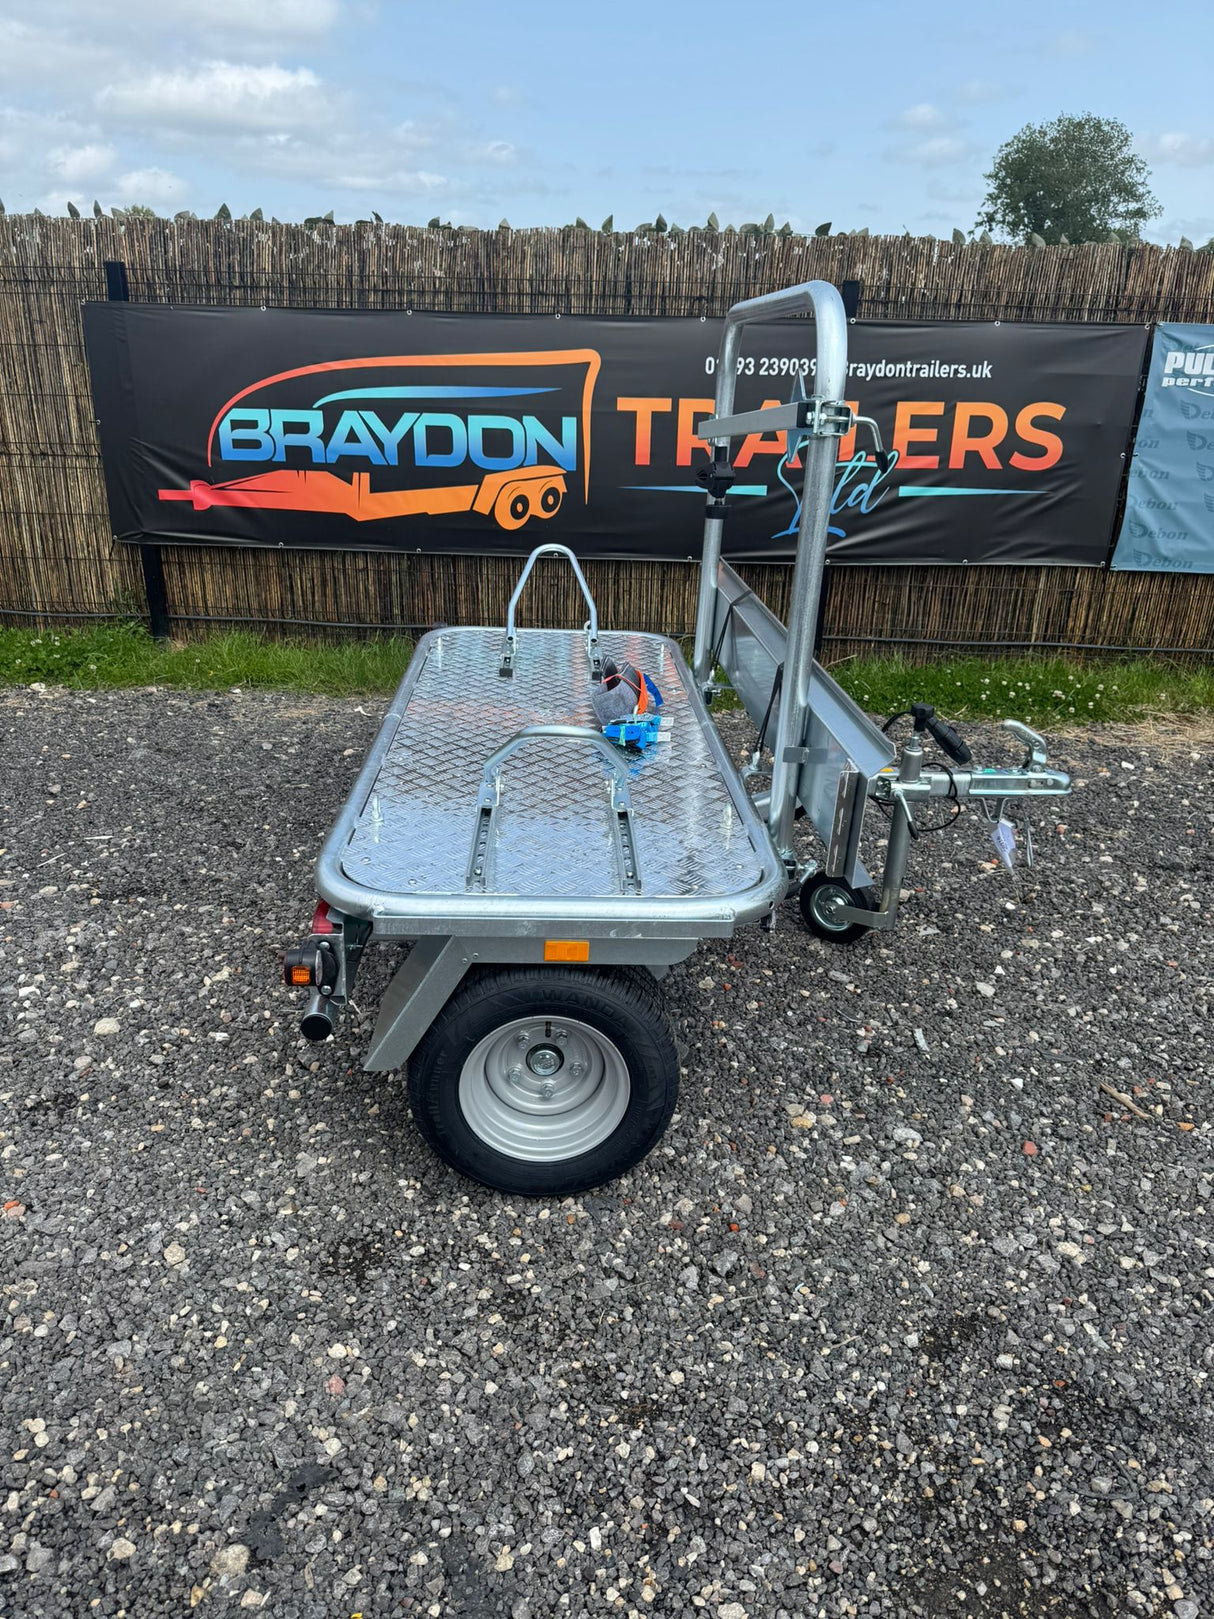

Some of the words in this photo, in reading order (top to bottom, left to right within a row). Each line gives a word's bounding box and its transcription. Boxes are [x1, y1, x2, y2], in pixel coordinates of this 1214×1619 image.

[705, 356, 755, 376] 093
[1161, 377, 1214, 388] perf
[218, 407, 577, 471] BRAYDON
[616, 397, 1067, 471] TRALERS
